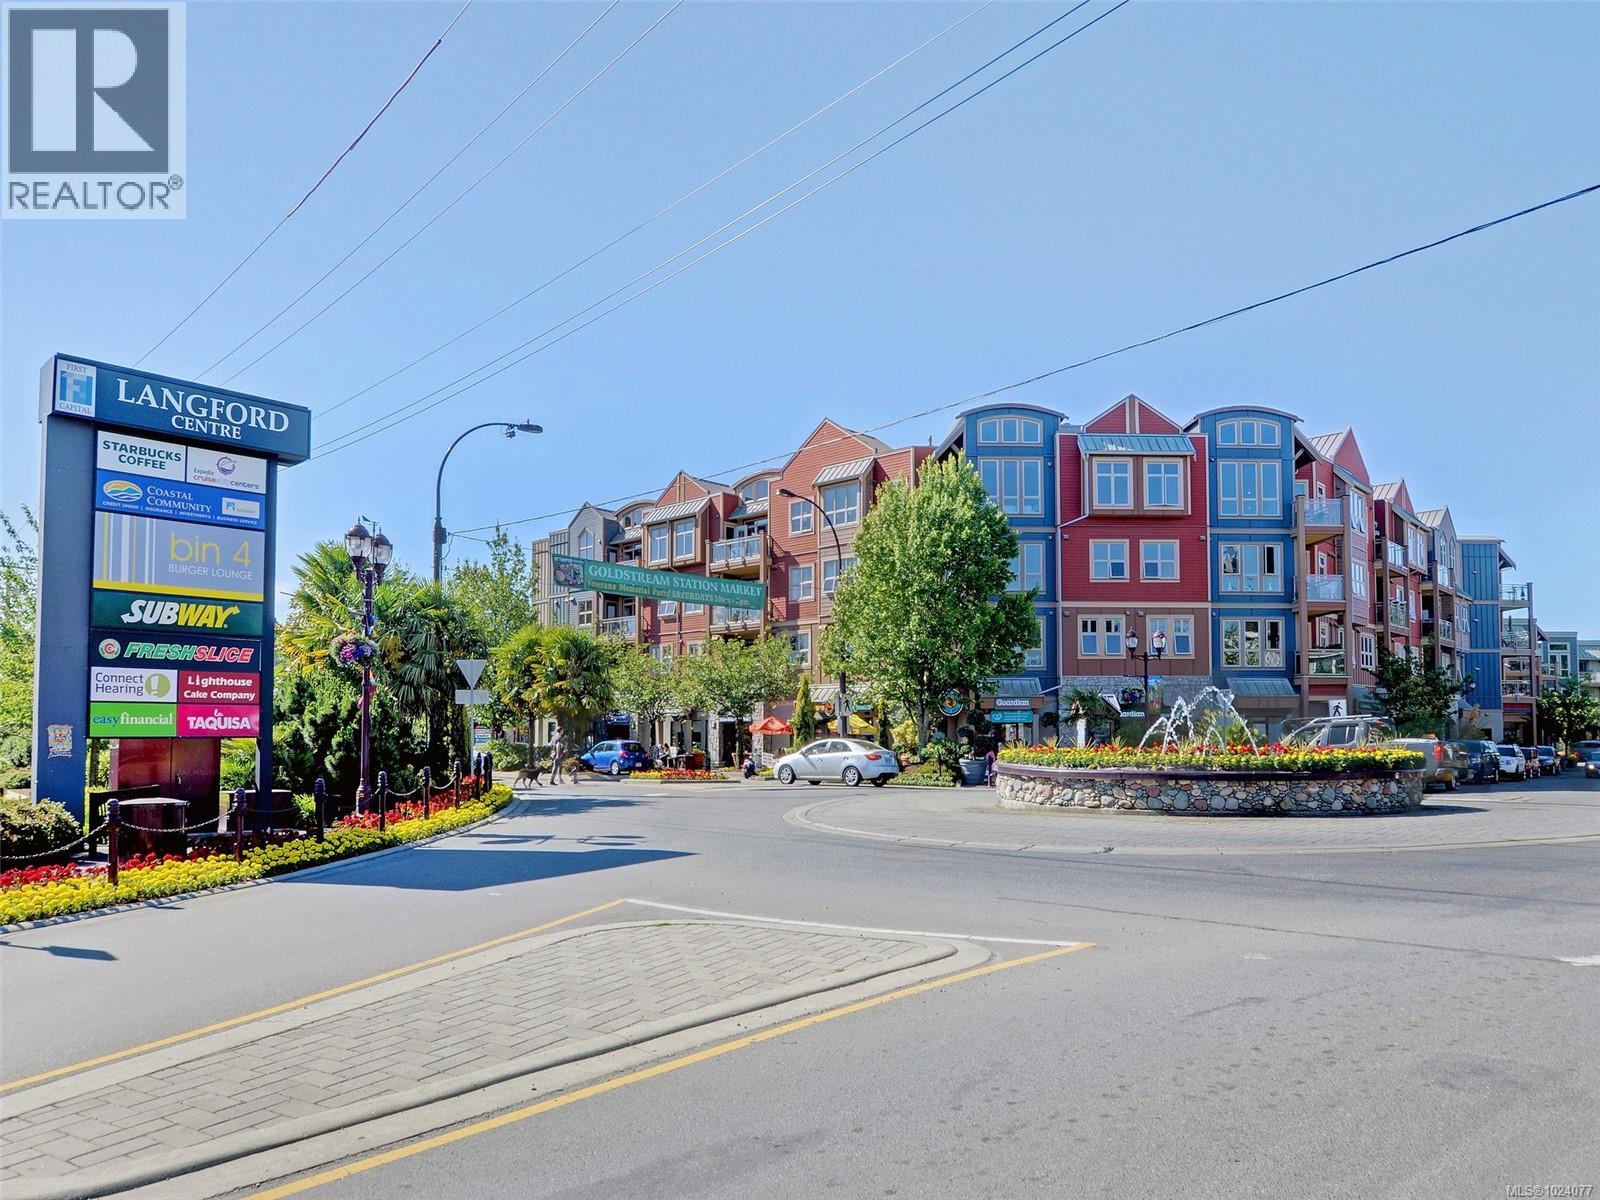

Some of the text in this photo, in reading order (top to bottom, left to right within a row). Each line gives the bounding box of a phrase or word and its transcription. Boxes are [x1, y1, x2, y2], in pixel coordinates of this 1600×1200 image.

[66, 364, 87, 373] FIRST
[59, 402, 92, 414] CAPITAL
[117, 378, 290, 432] LANGFORD
[171, 415, 242, 440] CENTRE
[102, 440, 182, 462] STARBUCKS
[118, 454, 166, 470] COFFEE
[147, 485, 194, 501] COASTAL
[146, 496, 212, 513] COMMUNITY
[170, 531, 251, 569] bin 4
[168, 563, 254, 580] BURGER LOUNGE
[587, 580, 617, 591] Veterans
[619, 583, 650, 595] Memorial
[588, 565, 763, 596] GOLDSTREAM STATION MARKET
[121, 599, 240, 629] SUBWAY
[123, 642, 255, 663] FRESHSLICE
[95, 672, 144, 684] Connect
[187, 674, 253, 688] Lighthouse
[95, 683, 144, 697] Hearing
[183, 690, 256, 702] Cake Company
[995, 699, 1030, 707] Guardian
[186, 716, 251, 730] TAQUISA
